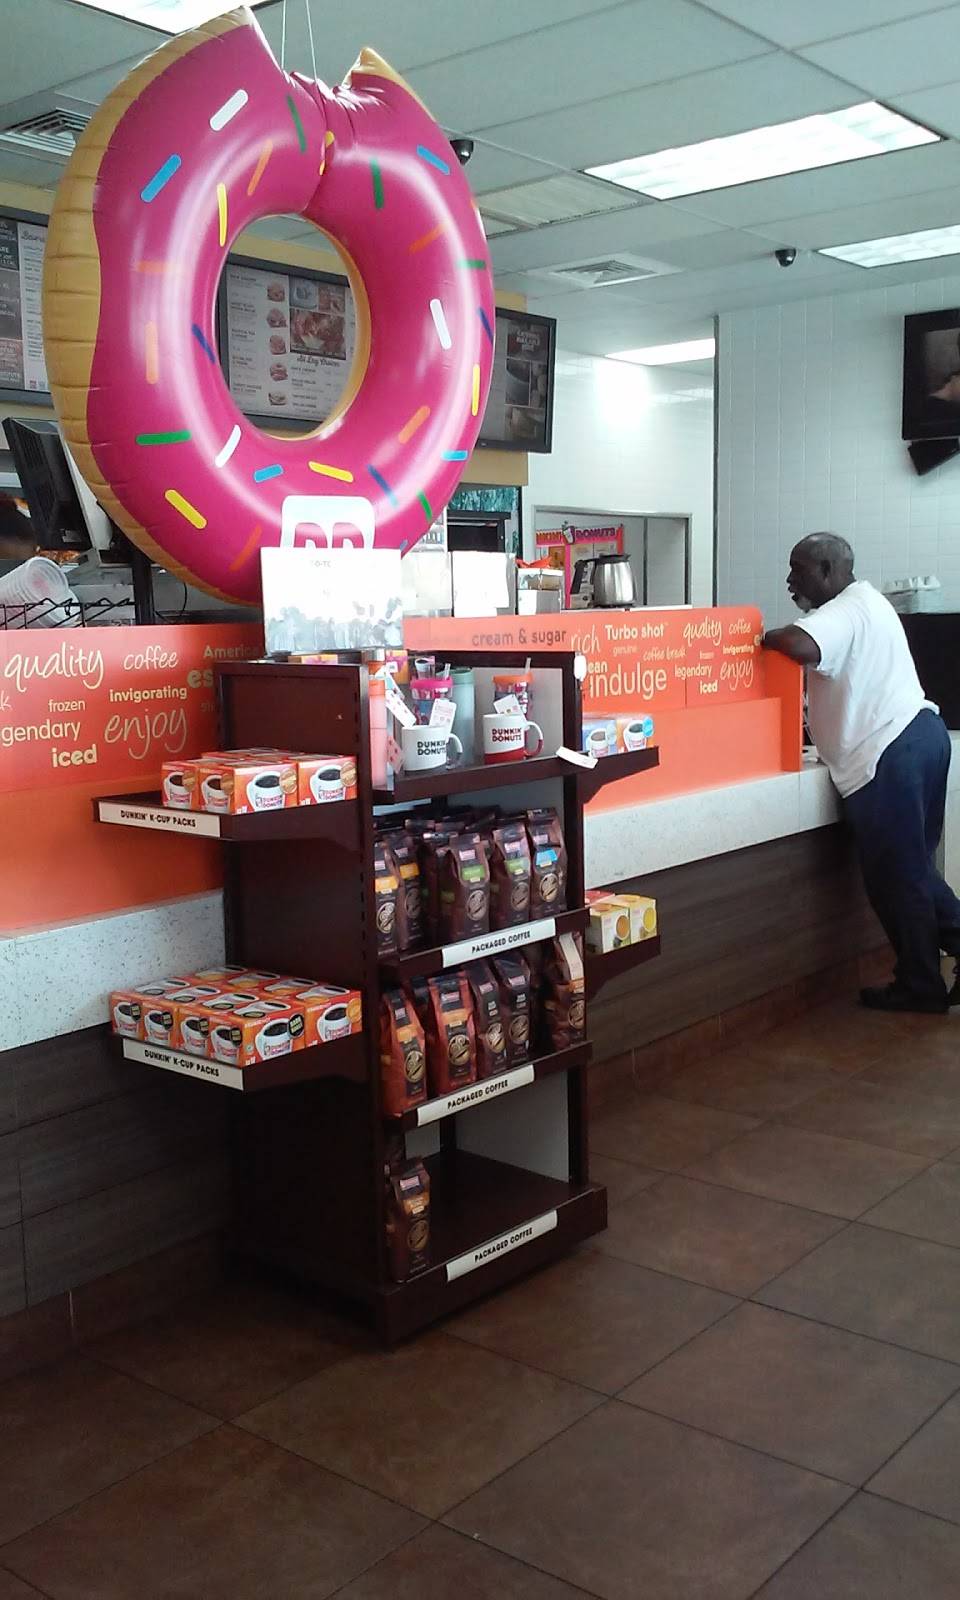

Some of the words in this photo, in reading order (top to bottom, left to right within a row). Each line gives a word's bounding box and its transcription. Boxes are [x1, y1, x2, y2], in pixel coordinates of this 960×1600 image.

[472, 632, 513, 647] cream
[518, 628, 527, 644] &
[531, 630, 567, 646] sugar
[605, 623, 638, 640] Turbo
[641, 623, 664, 638] shot
[683, 615, 722, 646] quality
[729, 618, 751, 635] coffee
[571, 624, 601, 654] rich
[123, 645, 179, 671] coffee
[642, 646, 665, 661] coffee
[666, 646, 687, 660] break
[4, 641, 104, 692] quality
[588, 661, 608, 674] ean
[675, 661, 712, 681] legendary
[719, 658, 754, 691] enjoy
[589, 662, 667, 700] indulge
[699, 679, 719, 695] iced
[109, 684, 187, 703] invigorating
[48, 699, 86, 713] frozen
[104, 707, 188, 760] enjoy
[492, 734, 522, 742] DONUTS
[52, 744, 98, 768] iced
[149, 815, 171, 825] K-CUP
[173, 817, 196, 828] PACKS
[471, 936, 507, 954] PACKAGED
[508, 929, 531, 945] COFFEE
[144, 1049, 172, 1065] DUNKIN'
[173, 1058, 194, 1071] K-CUP
[196, 1064, 220, 1077] PACKS
[447, 1088, 484, 1110] PACKAGED
[485, 1079, 509, 1095] COFFEE
[474, 1239, 509, 1263] PACKAGED
[510, 1226, 533, 1244] COFFEE
